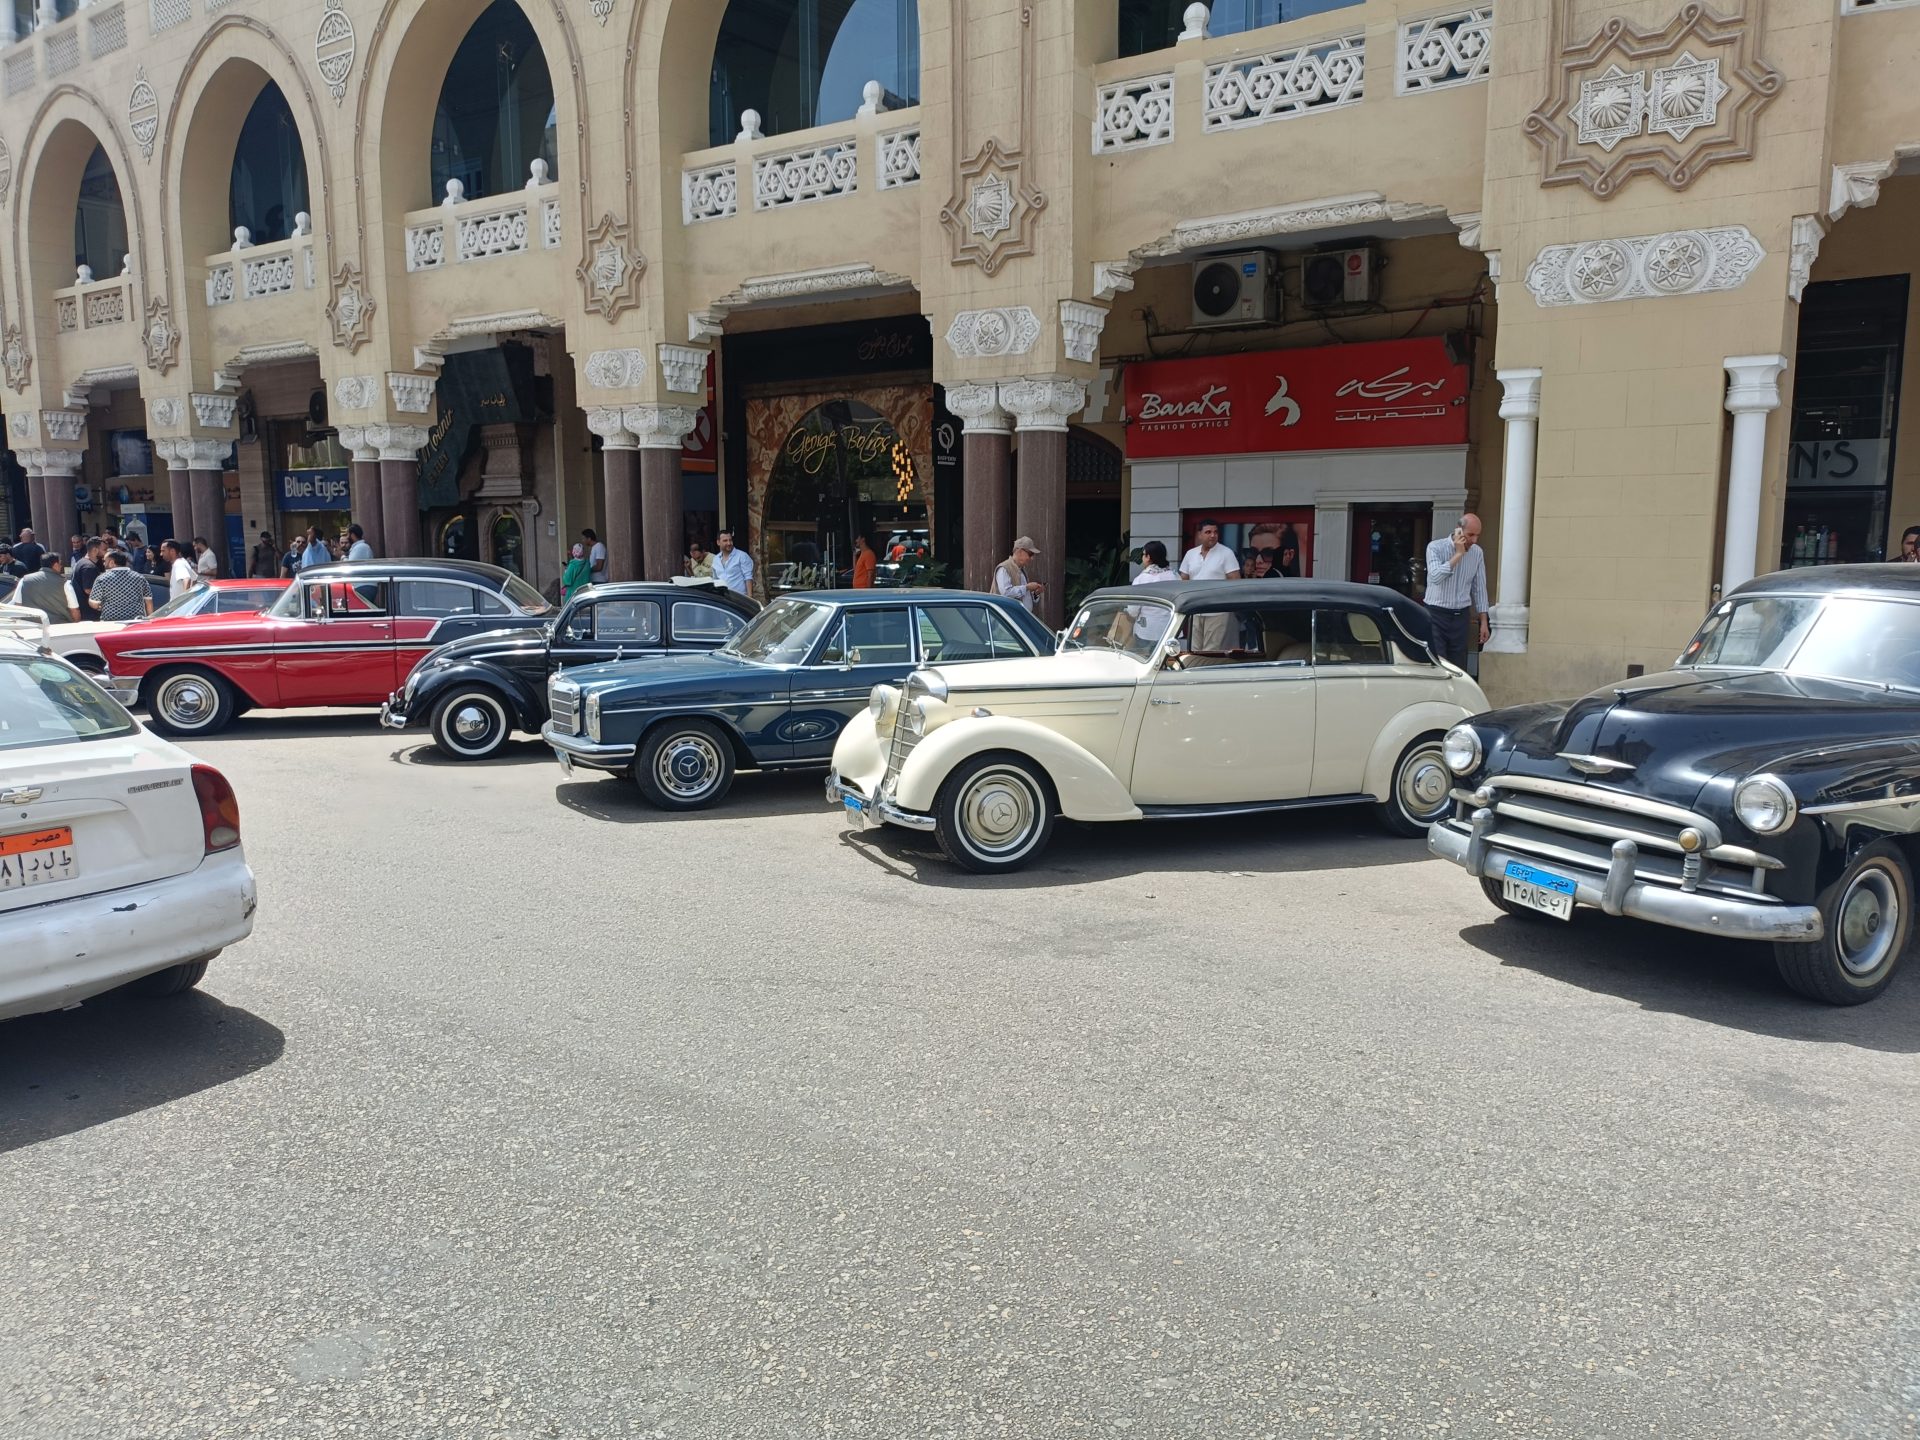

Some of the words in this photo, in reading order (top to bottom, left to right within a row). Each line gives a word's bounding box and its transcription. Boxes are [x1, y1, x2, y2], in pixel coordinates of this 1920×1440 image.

[1141, 423, 1185, 432] FASHION
[1191, 420, 1230, 429] OPTICS
[786, 427, 837, 474] George
[284, 475, 312, 498] Blue
[314, 475, 346, 503] Eyes
[31, 833, 61, 846] مصر
[1511, 865, 1535, 879] EGYPT
[1547, 877, 1569, 889] مصر
